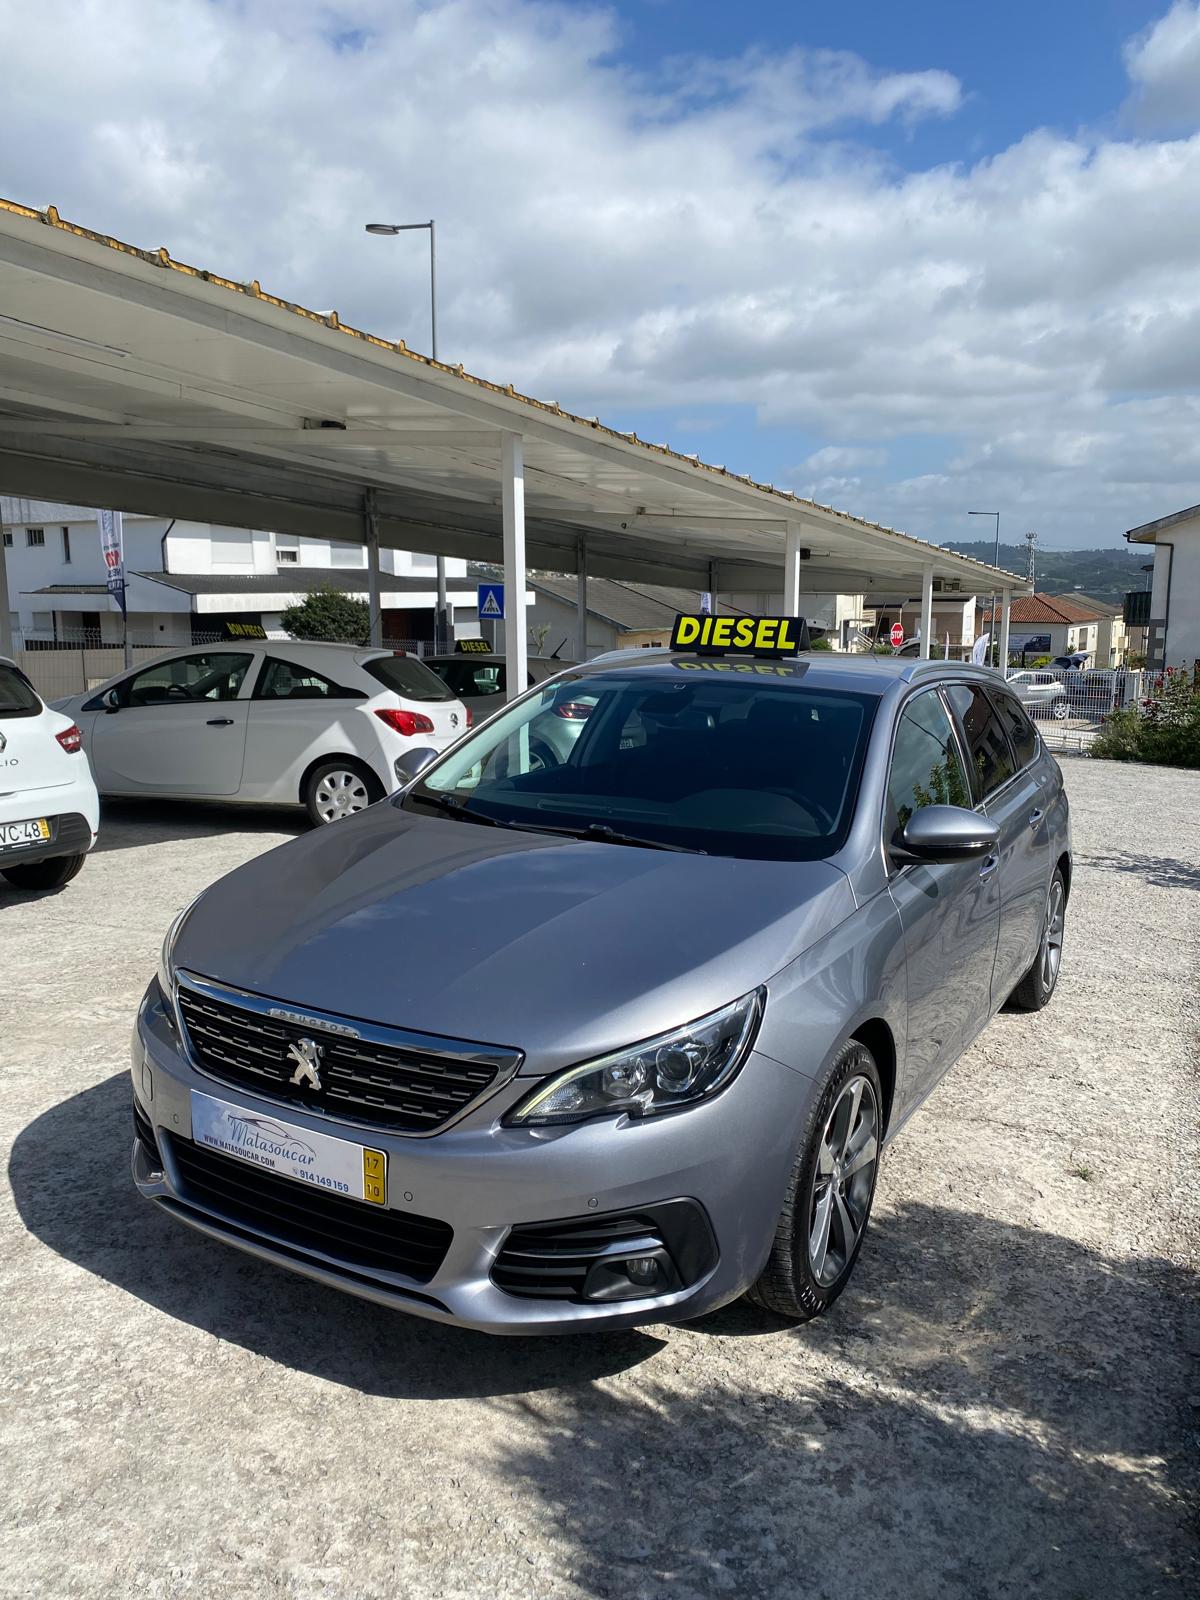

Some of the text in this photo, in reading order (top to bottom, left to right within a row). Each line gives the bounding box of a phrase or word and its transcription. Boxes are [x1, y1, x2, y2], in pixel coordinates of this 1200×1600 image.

[676, 616, 796, 650] DIESEL
[891, 630, 903, 639] STOP
[460, 641, 491, 651] DIESEL
[279, 1009, 349, 1033] PEUGEOT
[204, 1133, 276, 1169] WWW.MATASOUCAR.COM
[228, 1117, 315, 1166] Matasoucar
[366, 1157, 379, 1170] 17
[300, 1169, 349, 1193] 914 149 159
[367, 1183, 380, 1197] 10
